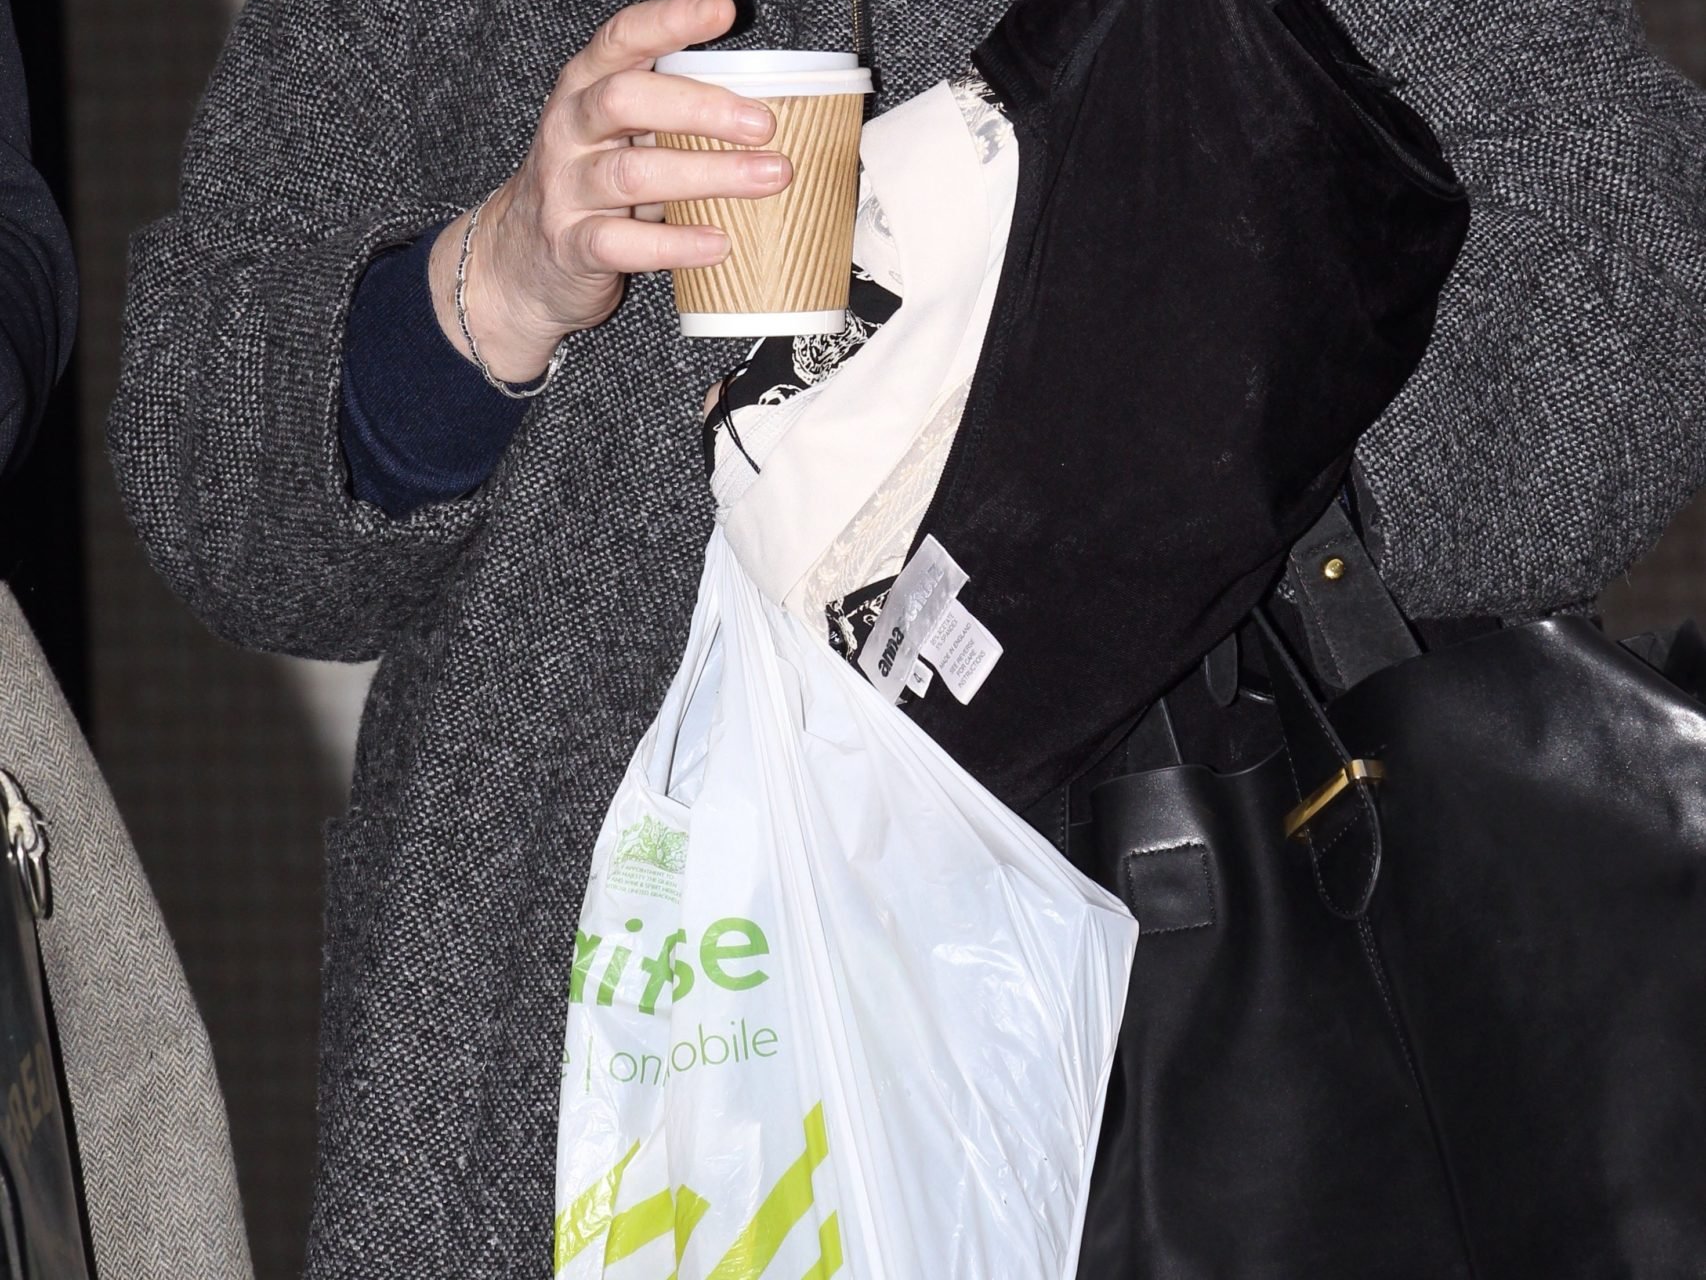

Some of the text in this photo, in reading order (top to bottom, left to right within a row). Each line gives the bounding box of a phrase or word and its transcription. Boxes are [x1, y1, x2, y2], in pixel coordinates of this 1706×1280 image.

[878, 627, 904, 677] anna
[940, 652, 951, 669] MADE
[952, 622, 972, 649] ENGLAND
[958, 650, 986, 687] INSTRUCTIONS
[913, 672, 925, 684] 4
[671, 1018, 778, 1072] obile
